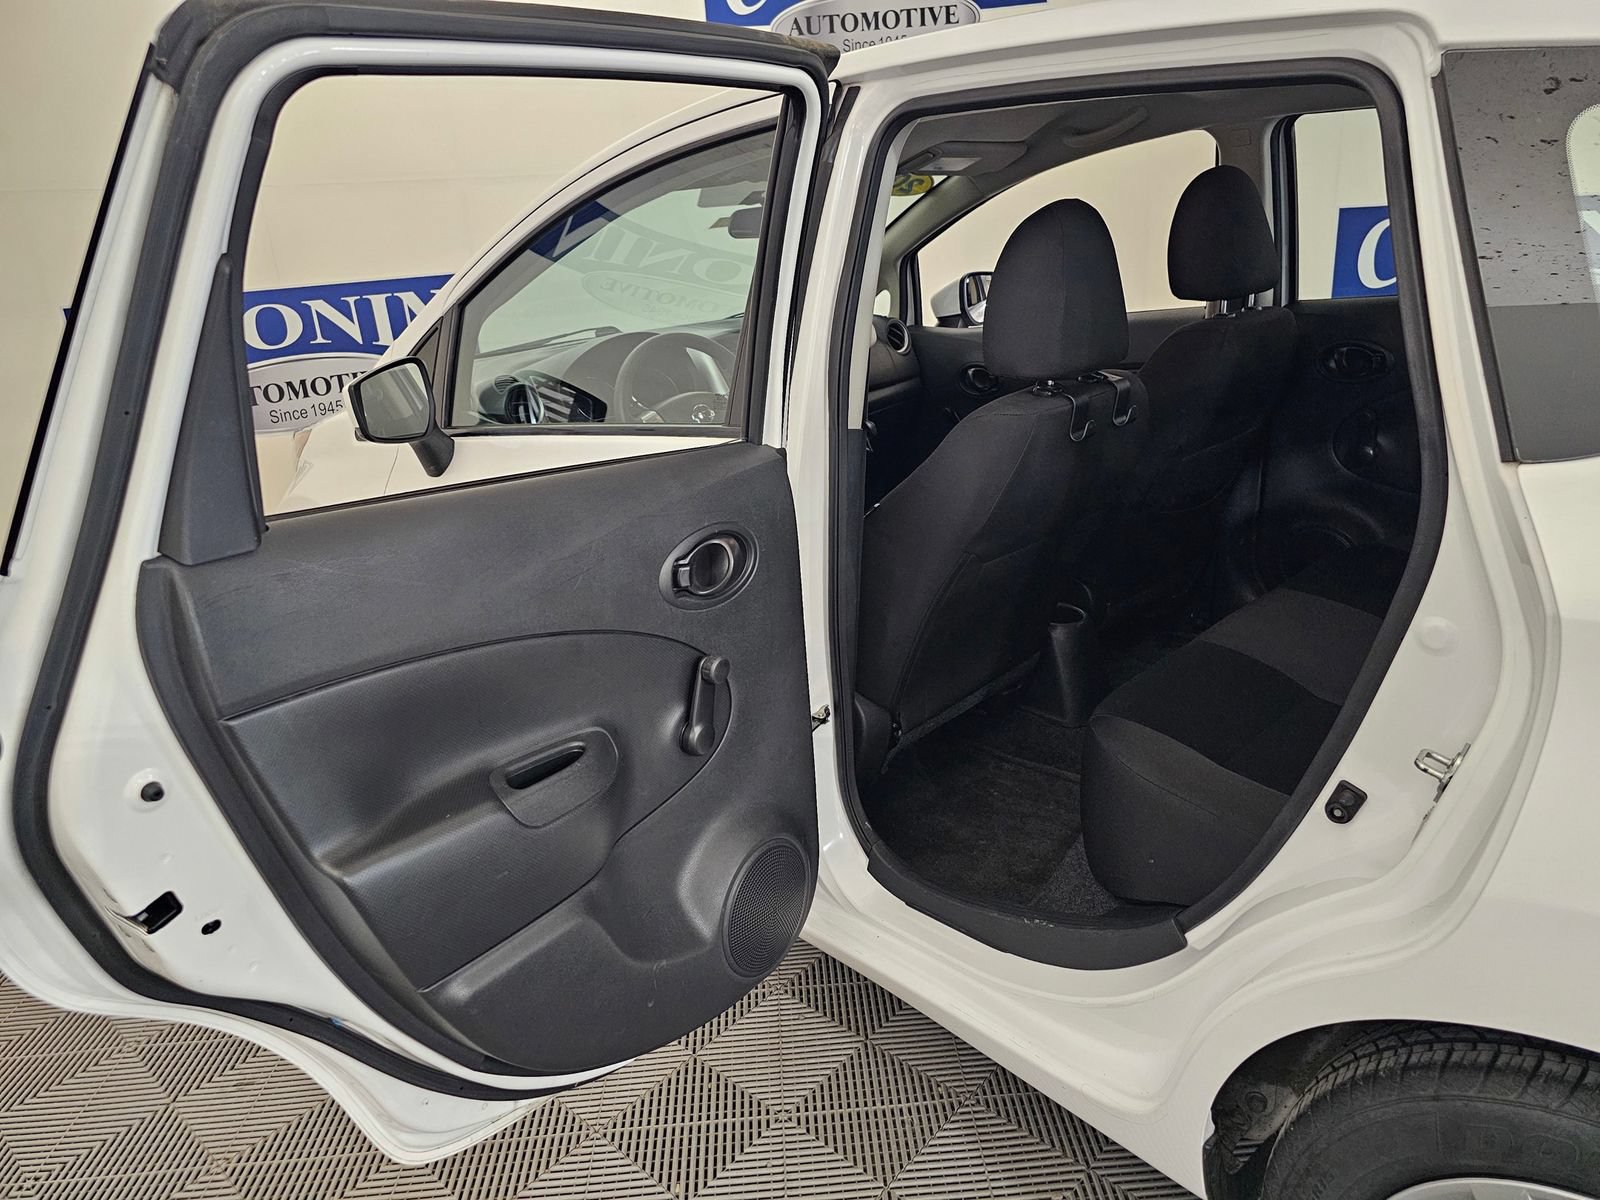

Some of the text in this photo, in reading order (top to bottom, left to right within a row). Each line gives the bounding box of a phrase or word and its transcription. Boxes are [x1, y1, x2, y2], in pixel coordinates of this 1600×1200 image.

[788, 4, 960, 36] AUTOMOTIVE
[269, 399, 344, 424] Since 1945
